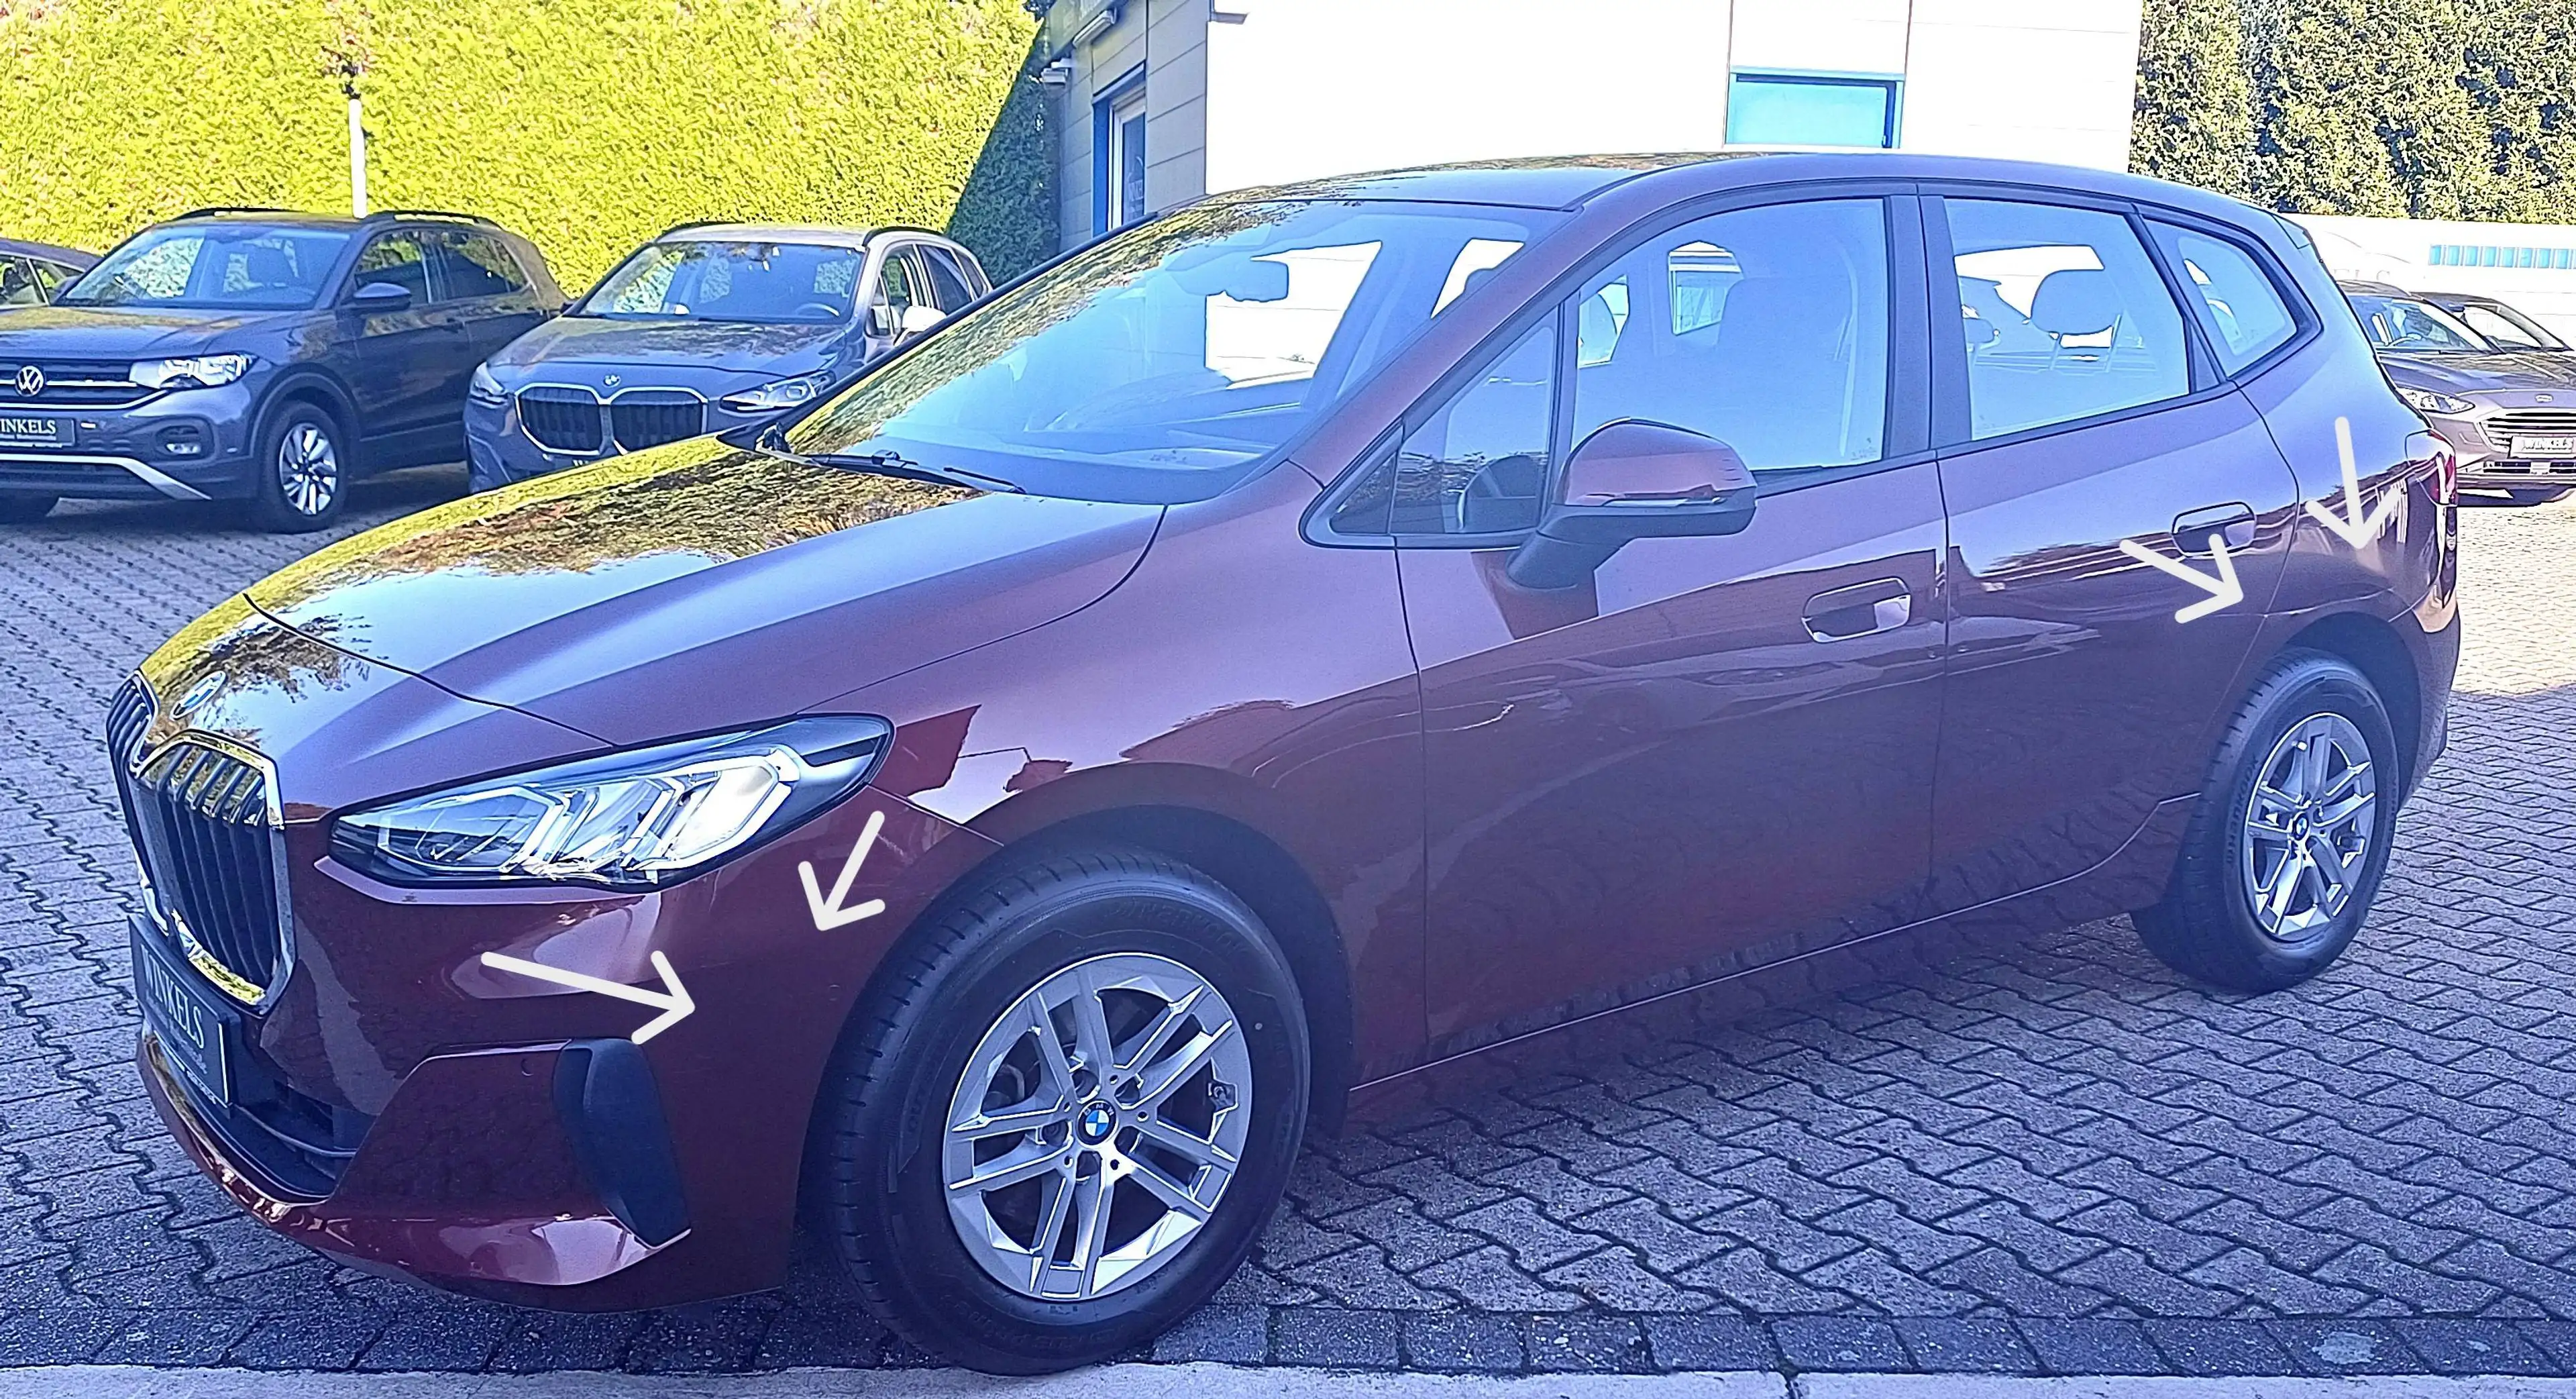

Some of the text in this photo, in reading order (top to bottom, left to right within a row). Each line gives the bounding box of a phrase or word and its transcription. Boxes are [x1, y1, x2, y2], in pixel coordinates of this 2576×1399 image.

[0, 419, 56, 434] INKELS
[140, 943, 204, 1049] WINKELS
[1083, 1103, 1114, 1116] BMW
